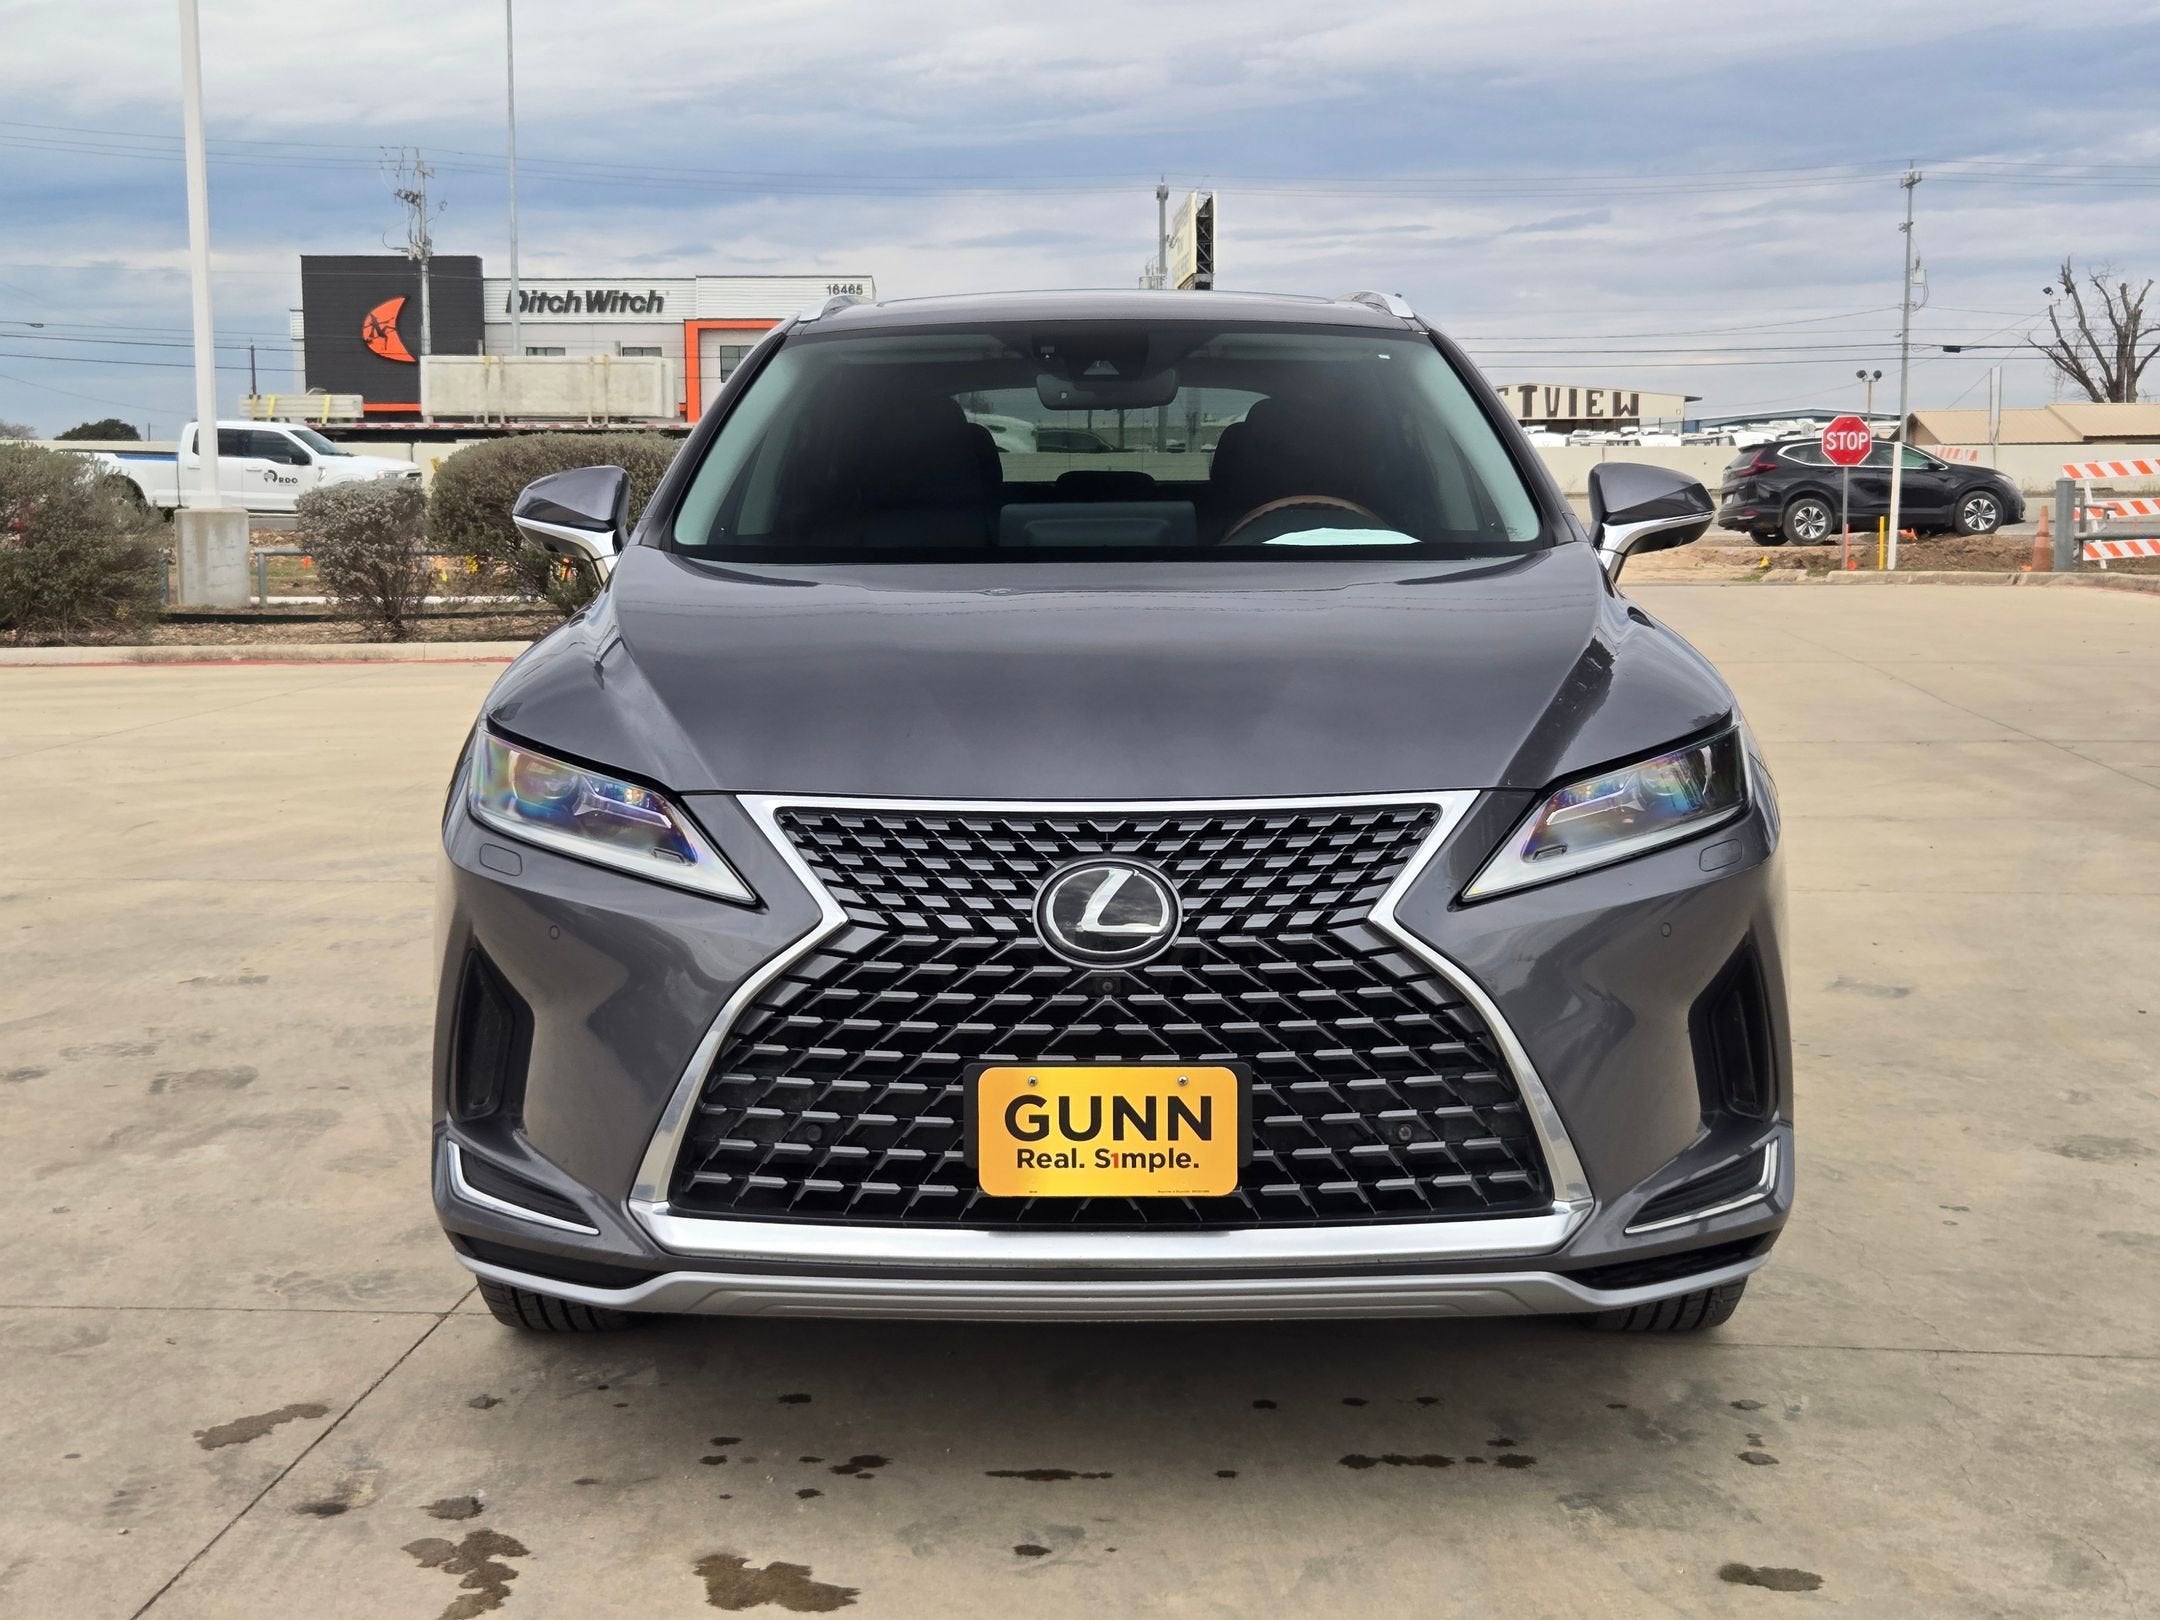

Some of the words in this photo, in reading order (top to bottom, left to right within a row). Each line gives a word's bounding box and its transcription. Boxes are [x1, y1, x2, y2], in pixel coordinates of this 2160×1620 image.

[826, 284, 864, 296] 16465
[505, 290, 583, 313] Ditch
[585, 290, 665, 313] Witch
[1497, 385, 1639, 418] TVIEW
[1826, 431, 1869, 450] STOP
[1004, 1094, 1212, 1142] GUNN
[1017, 1148, 1085, 1169] Real.
